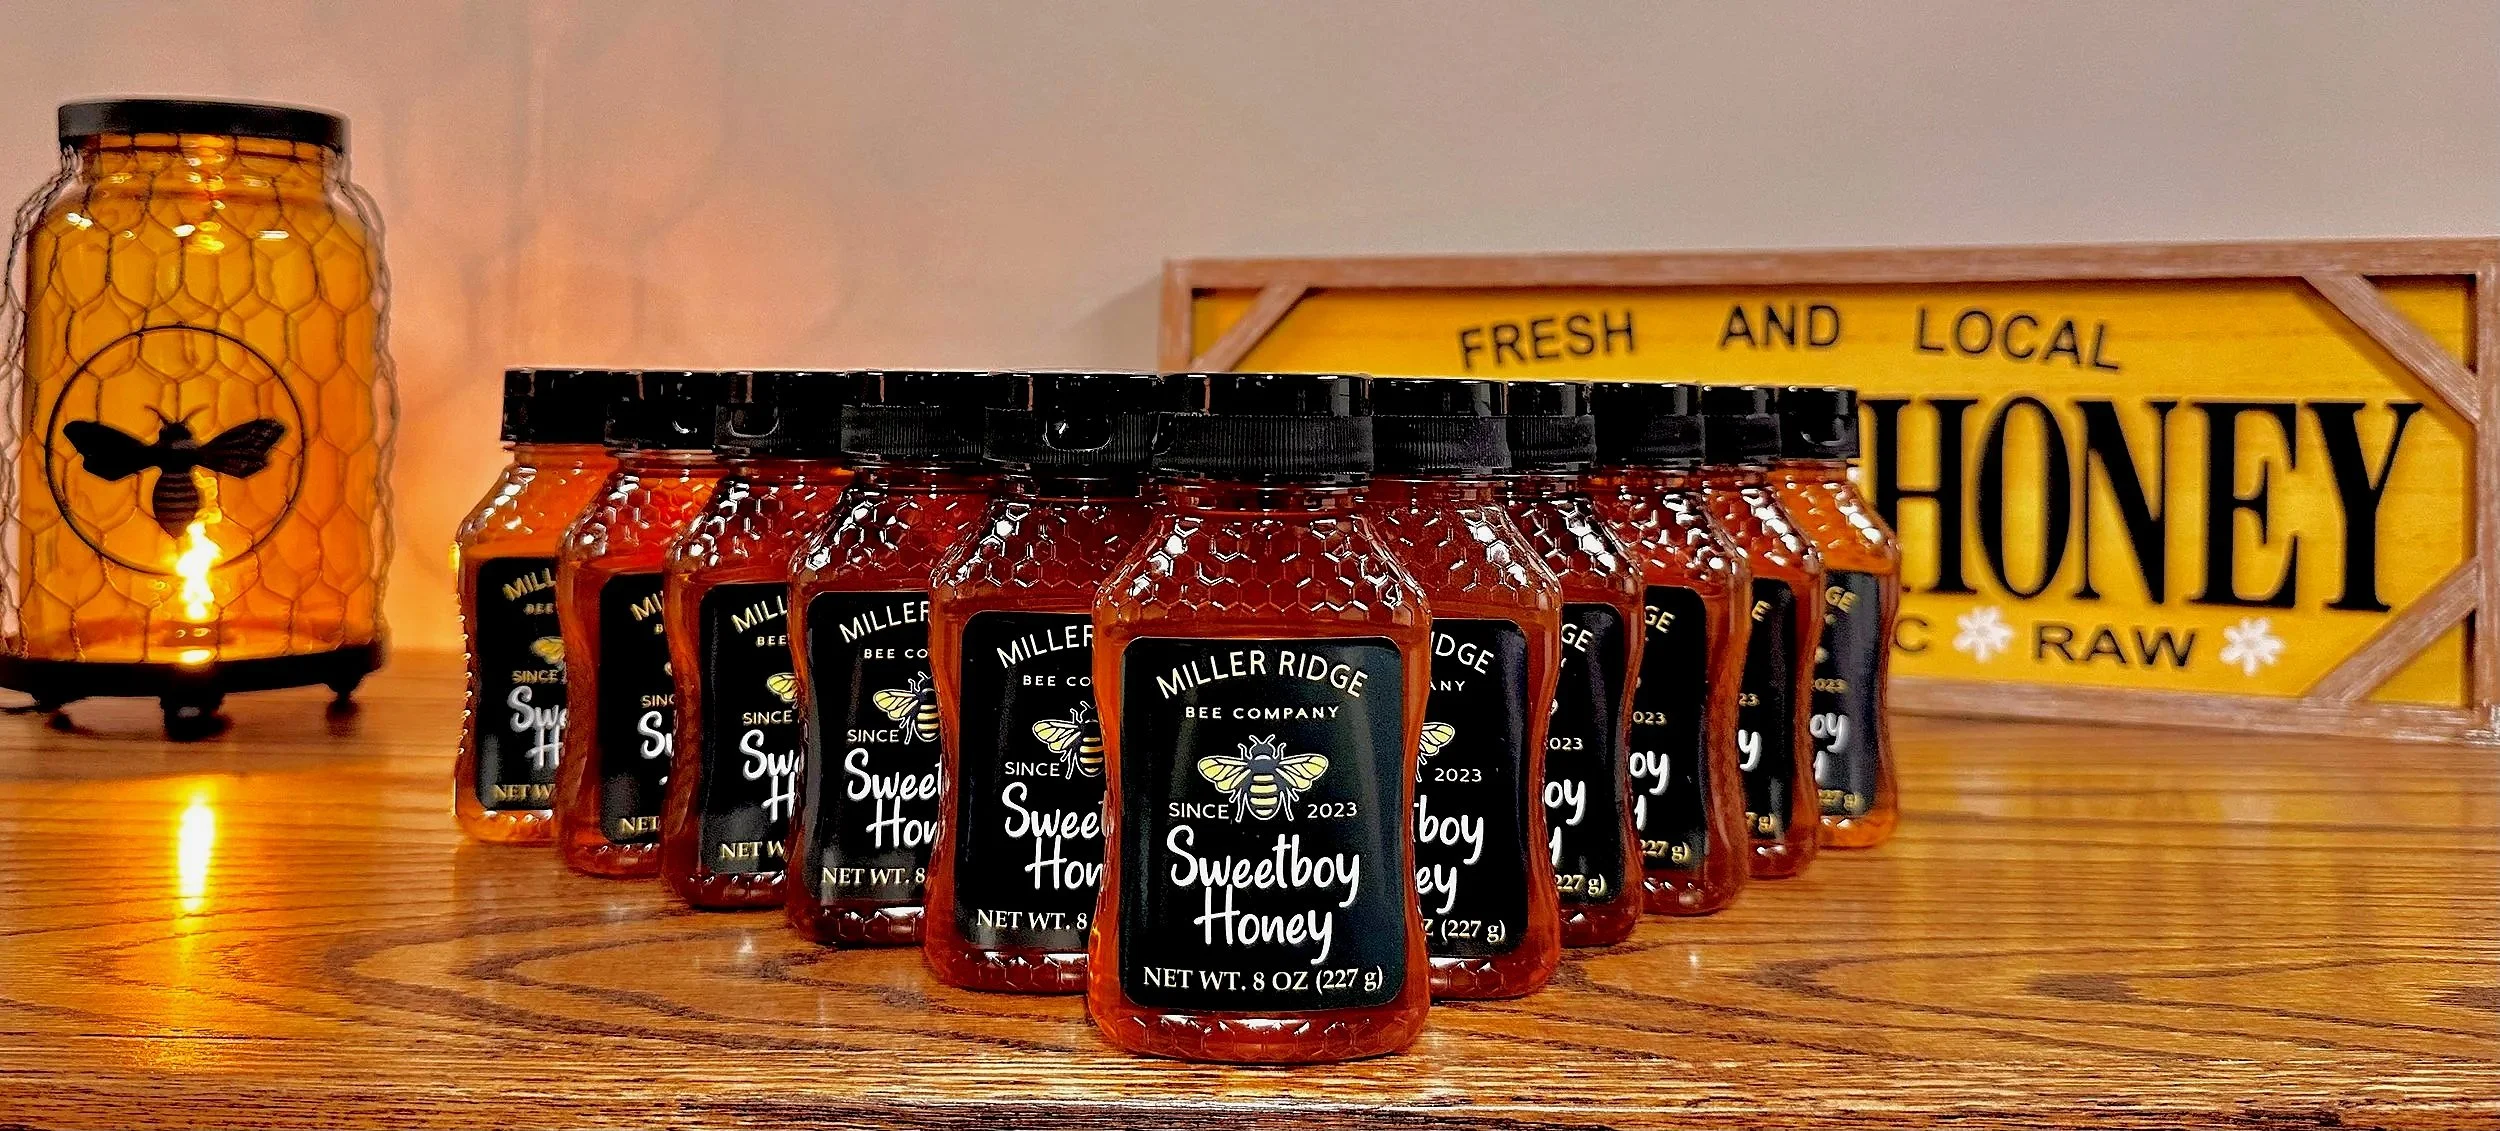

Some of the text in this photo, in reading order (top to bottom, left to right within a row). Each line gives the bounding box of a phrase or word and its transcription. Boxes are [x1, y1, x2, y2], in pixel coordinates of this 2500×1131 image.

[1460, 304, 2120, 372] FRESH AND LOCAL
[1858, 394, 2422, 614] HONEY
[756, 635, 787, 647] BEE
[2035, 624, 2197, 668] RAW
[864, 648, 895, 659] BEE
[511, 670, 559, 684] SINCE
[1023, 675, 1056, 686] BEE
[1156, 649, 1368, 700] MILLER RIDGE
[743, 709, 793, 726] SINCE
[1185, 705, 1340, 720] BEE COMPANY
[847, 729, 900, 743] SINCE
[1547, 737, 1583, 751] 023
[1004, 761, 1060, 777] SINCE
[1434, 767, 1482, 783] 2023
[1168, 802, 1358, 820] SINCE 2023
[720, 841, 762, 860] NET
[1671, 841, 1692, 865] g)
[1166, 824, 1360, 908] Sweetboy
[821, 867, 926, 885] NET WT. 8
[1587, 873, 1608, 897] g)
[976, 908, 1088, 930] NET WT. 8
[1193, 883, 1332, 966] Honey
[1441, 919, 1482, 943] (227
[1486, 919, 1506, 943] g)
[1143, 965, 1384, 994] NET WT. 8 OZ (227 g)
